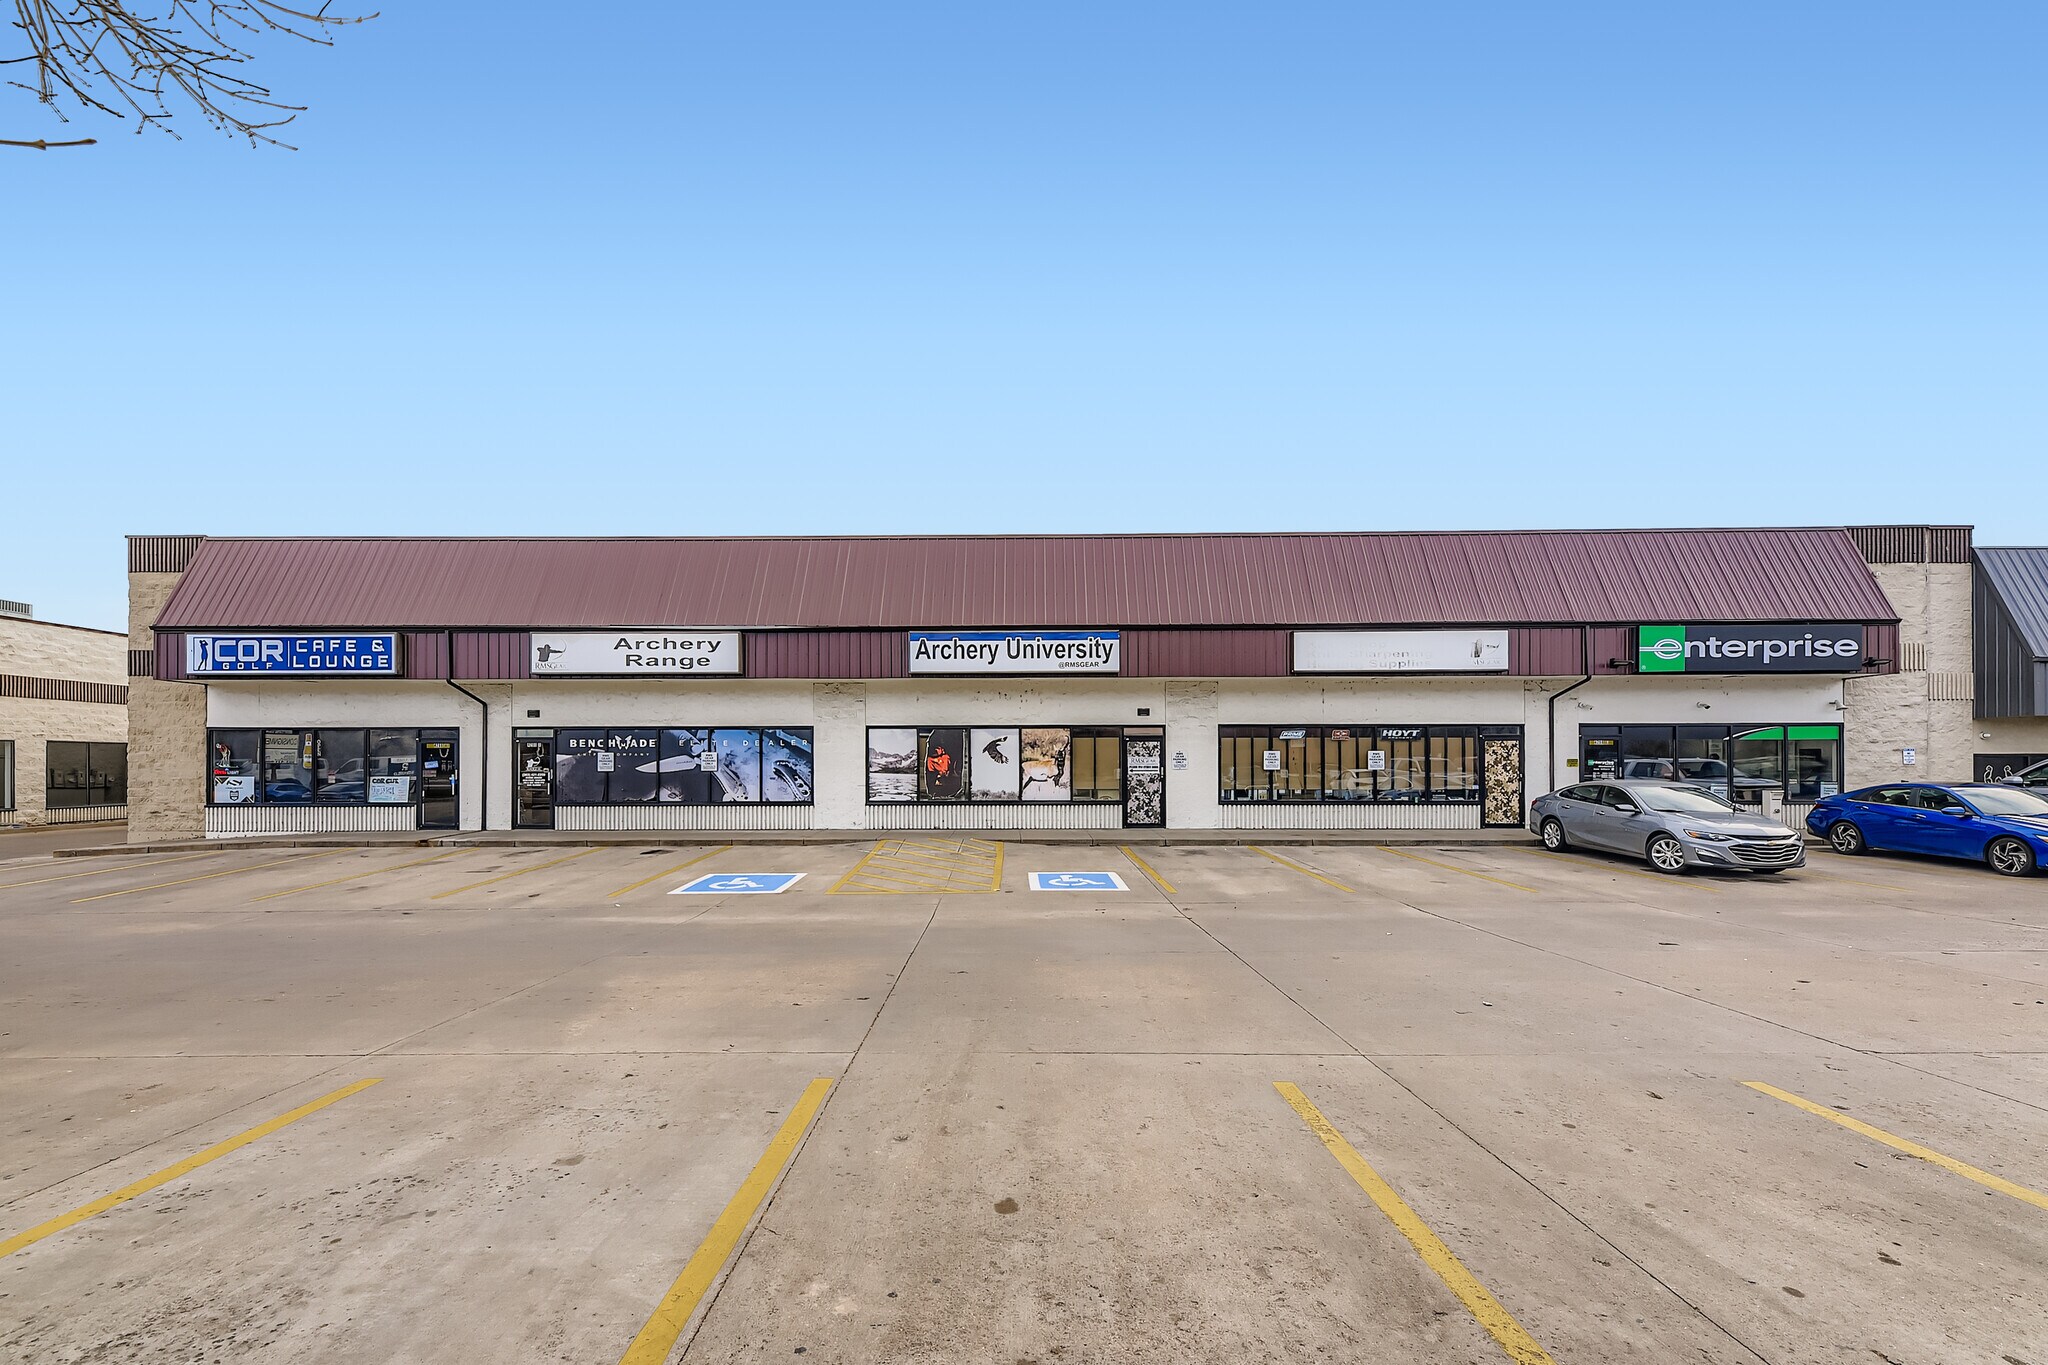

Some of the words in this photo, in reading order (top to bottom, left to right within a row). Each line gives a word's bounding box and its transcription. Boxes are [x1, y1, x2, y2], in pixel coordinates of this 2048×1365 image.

[214, 639, 284, 662] COR
[296, 640, 357, 652] CAFE
[371, 640, 385, 652] &
[613, 637, 722, 652] Archery
[915, 638, 999, 664] Archery
[1006, 637, 1114, 664] University
[1640, 633, 1859, 664] enterprise
[222, 662, 273, 670] GOLF
[292, 655, 389, 668] LOUNGE
[625, 654, 711, 670] Range
[1382, 729, 1420, 737] HOYT
[743, 739, 808, 747] DEALER
